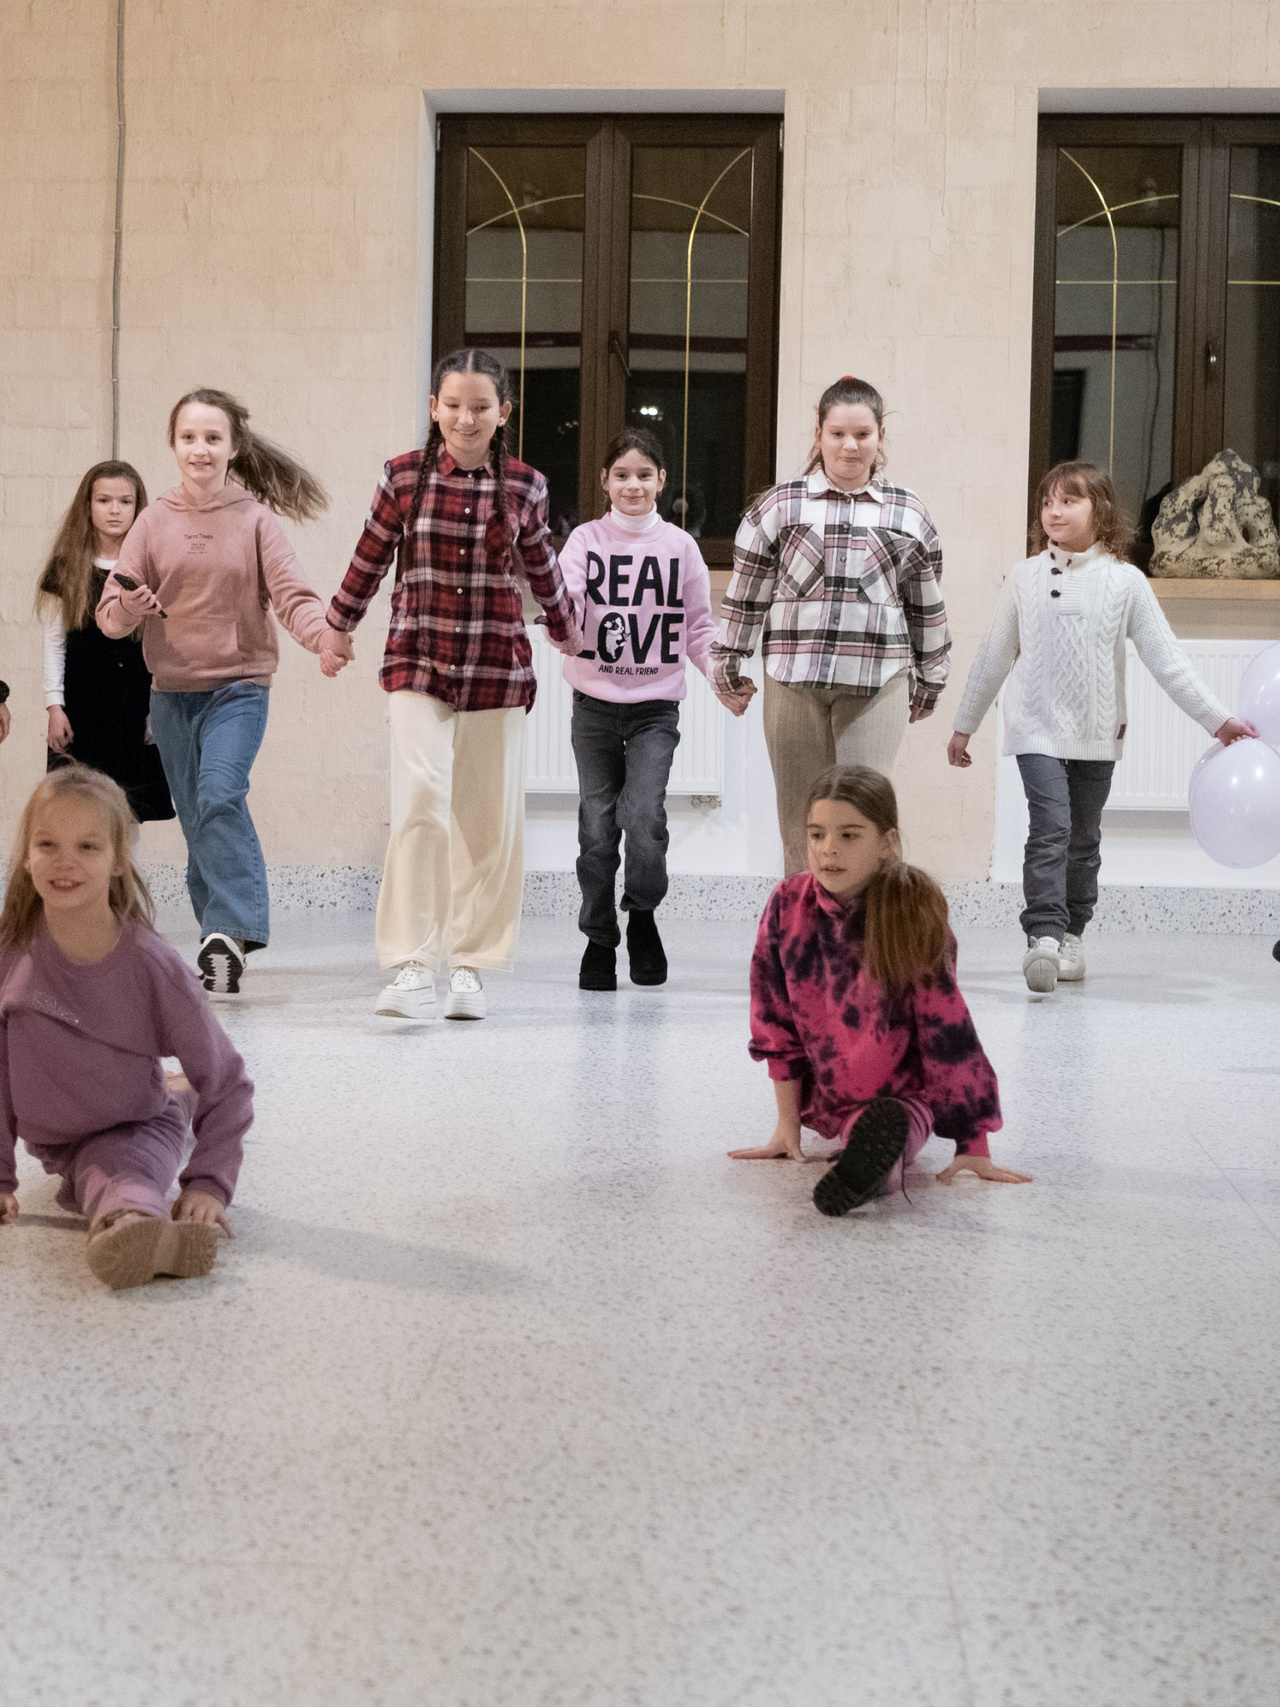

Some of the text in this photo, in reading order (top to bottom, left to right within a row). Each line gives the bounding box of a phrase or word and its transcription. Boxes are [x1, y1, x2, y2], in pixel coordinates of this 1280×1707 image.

[586, 551, 685, 608] REAL
[598, 664, 659, 676] AND REAL FRIEND
